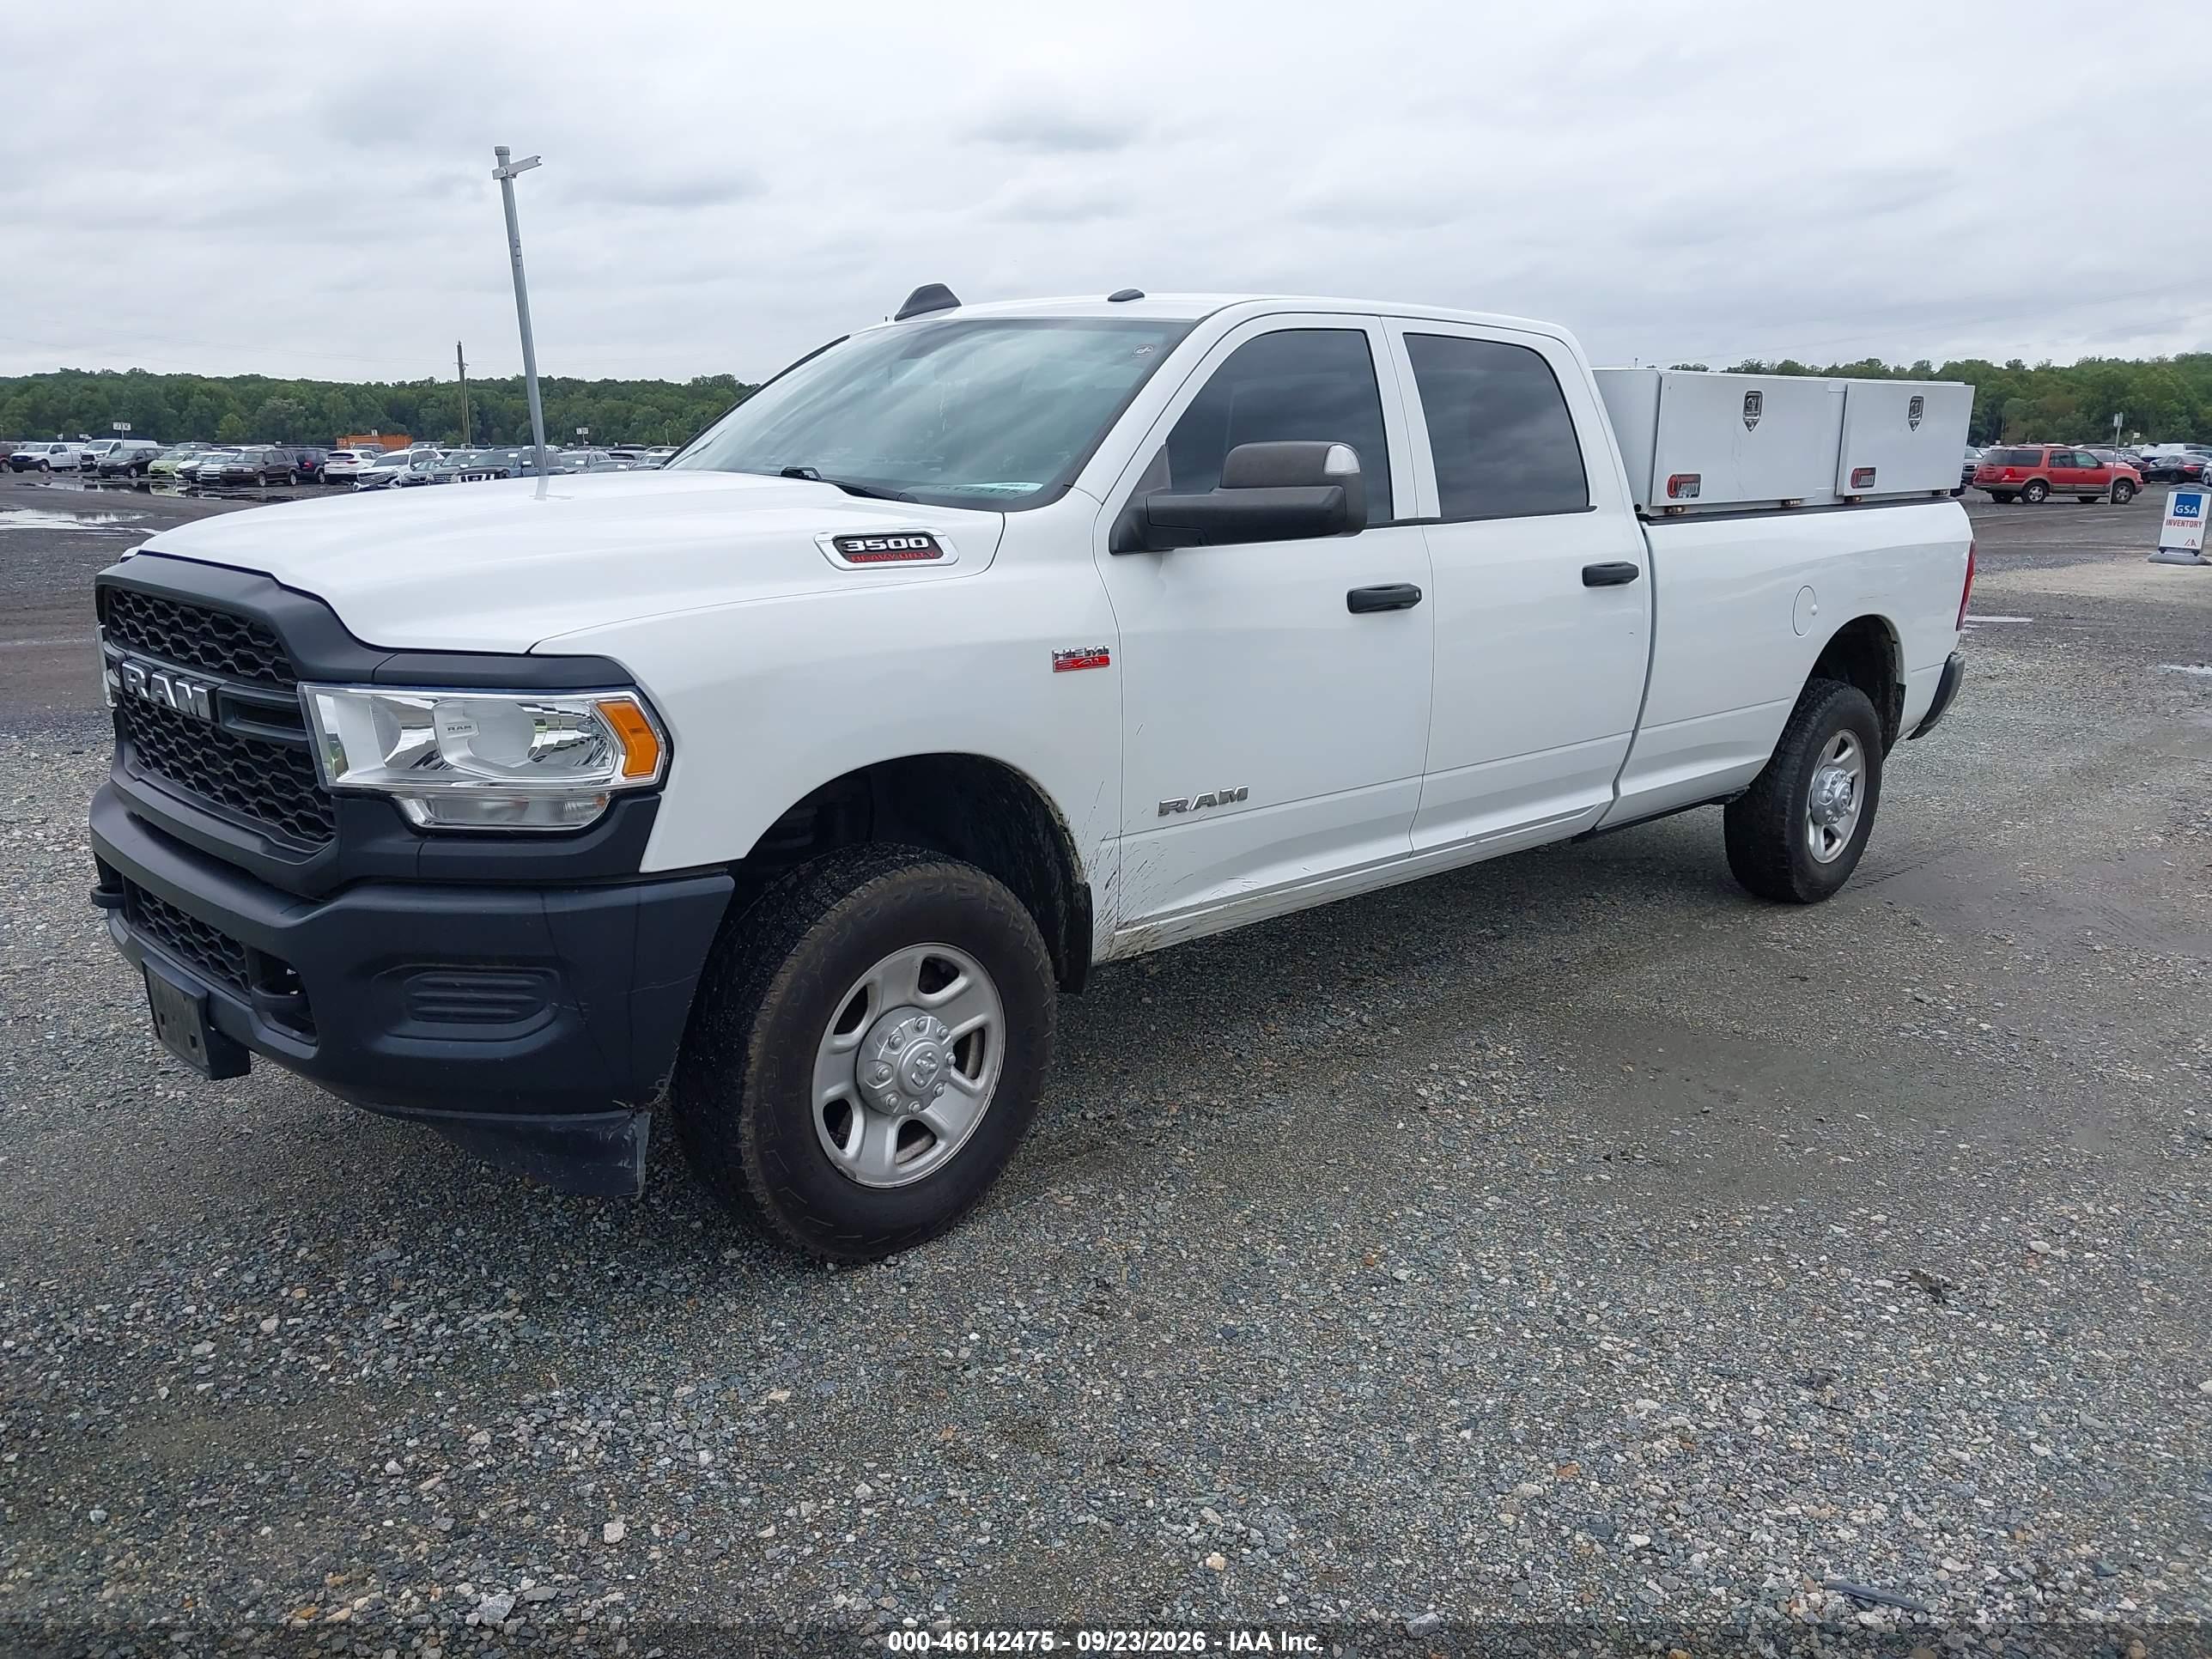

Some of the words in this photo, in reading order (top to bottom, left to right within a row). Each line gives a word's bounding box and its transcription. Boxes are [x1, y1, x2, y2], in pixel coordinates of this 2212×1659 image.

[2175, 505, 2198, 515] GSA
[2166, 519, 2203, 529] INVENTORY
[843, 537, 929, 552] 3500
[850, 554, 896, 563] HEAVY
[1052, 646, 1110, 659] HEMI
[122, 660, 212, 720] RAM
[1158, 785, 1249, 817] RAM
